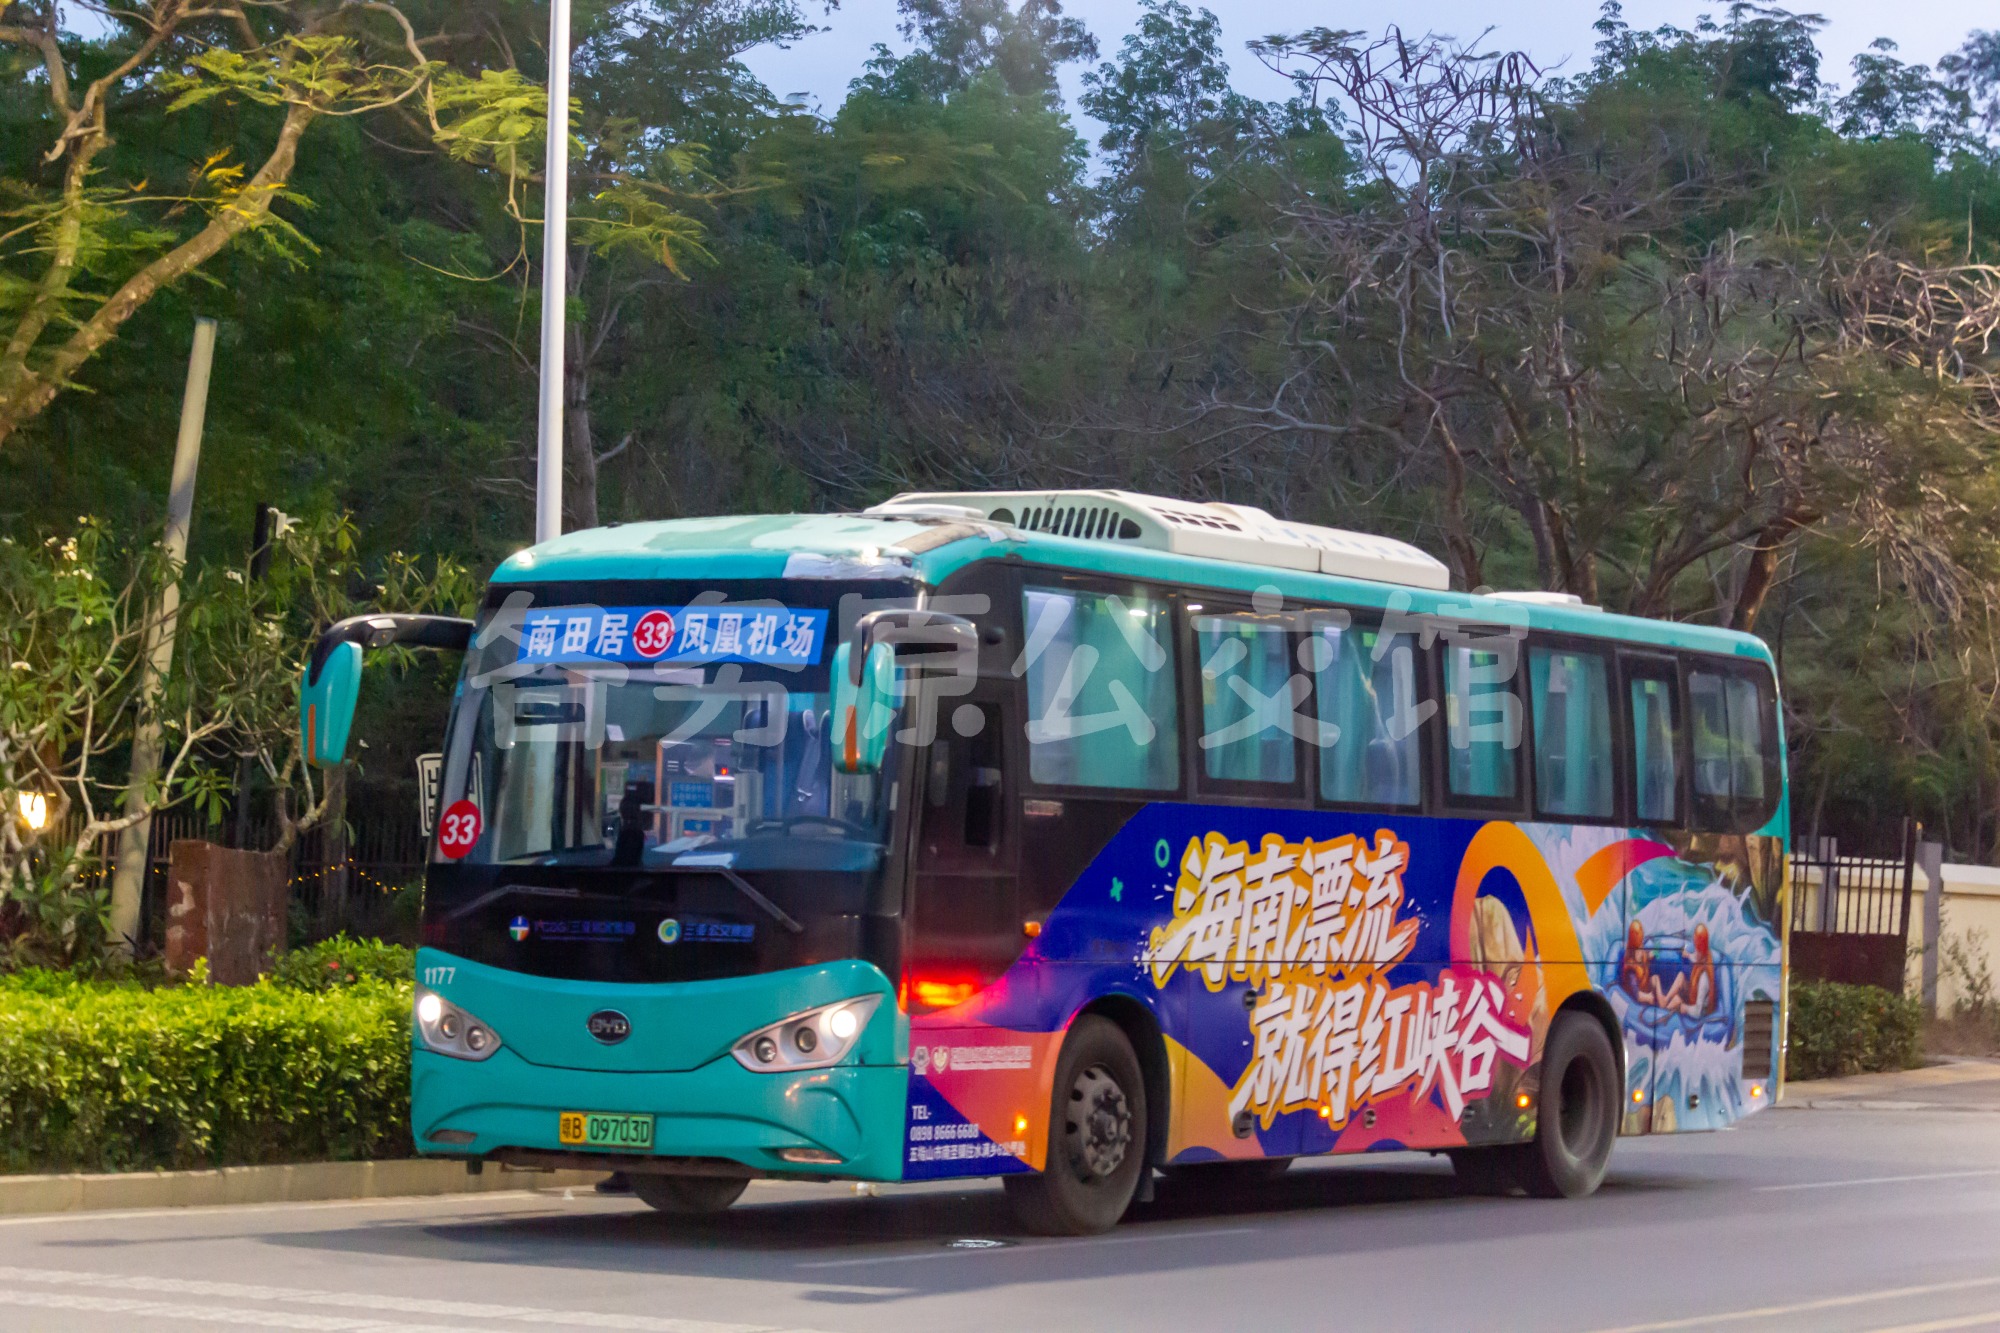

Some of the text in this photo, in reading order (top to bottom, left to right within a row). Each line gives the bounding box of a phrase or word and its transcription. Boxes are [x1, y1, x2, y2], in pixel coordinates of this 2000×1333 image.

[527, 612, 816, 659] 南田居 33 凤凰机场
[442, 813, 480, 845] 33
[1148, 837, 1414, 983] 海南漂流
[424, 967, 456, 984] 1177
[591, 1018, 627, 1035] BYD
[1230, 978, 1530, 1122] 就得红峡谷
